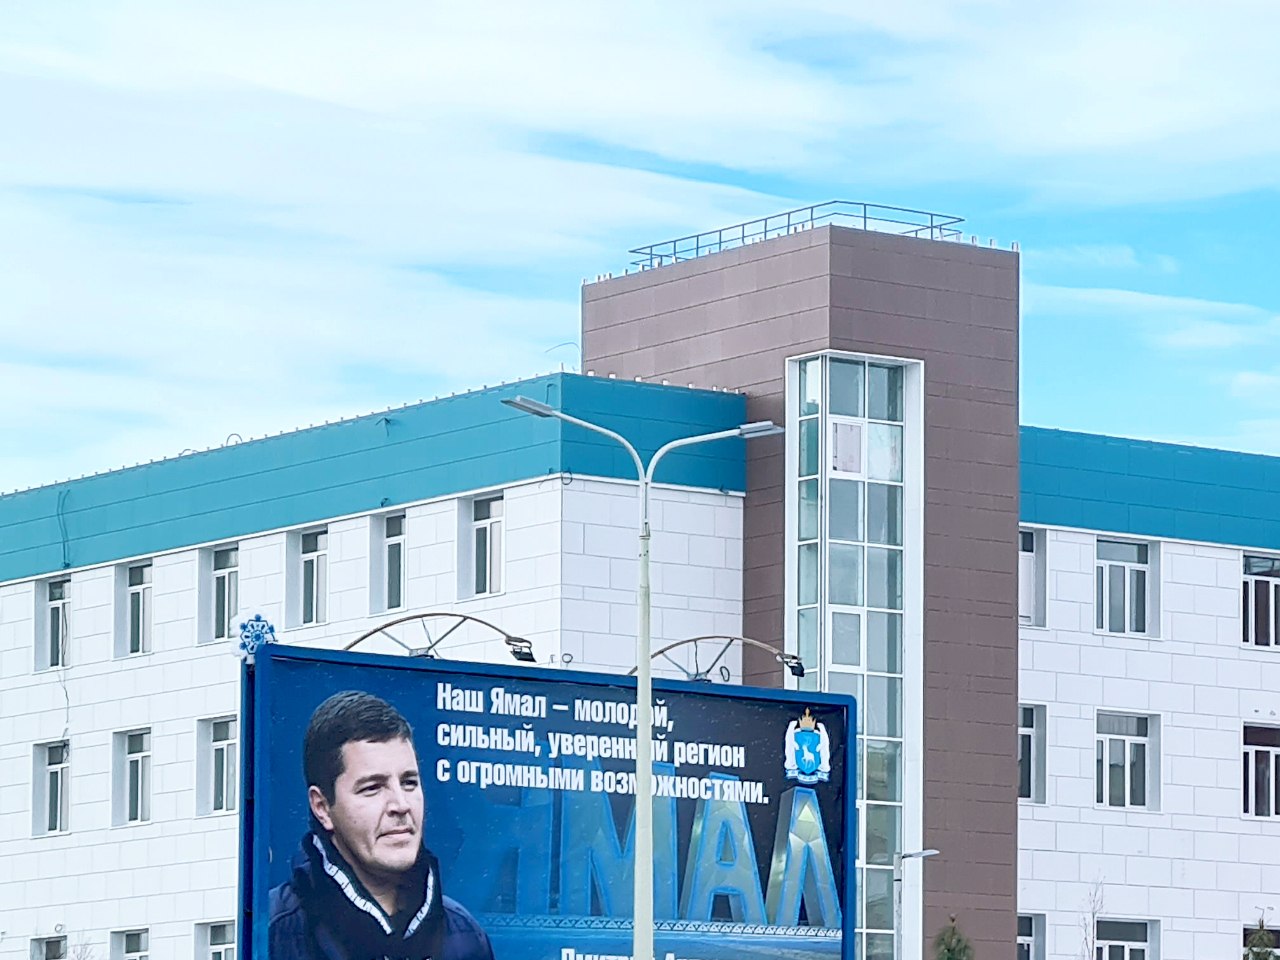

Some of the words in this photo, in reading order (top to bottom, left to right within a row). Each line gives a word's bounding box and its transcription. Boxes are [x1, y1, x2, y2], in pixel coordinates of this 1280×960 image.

[436, 682, 484, 713] Наш
[490, 687, 547, 718] Ямал
[574, 698, 674, 732] молодй,
[437, 722, 542, 757] сильный,
[548, 732, 668, 762] увереннй
[674, 741, 745, 767] регион
[436, 759, 450, 782] с
[457, 760, 584, 791] огромными
